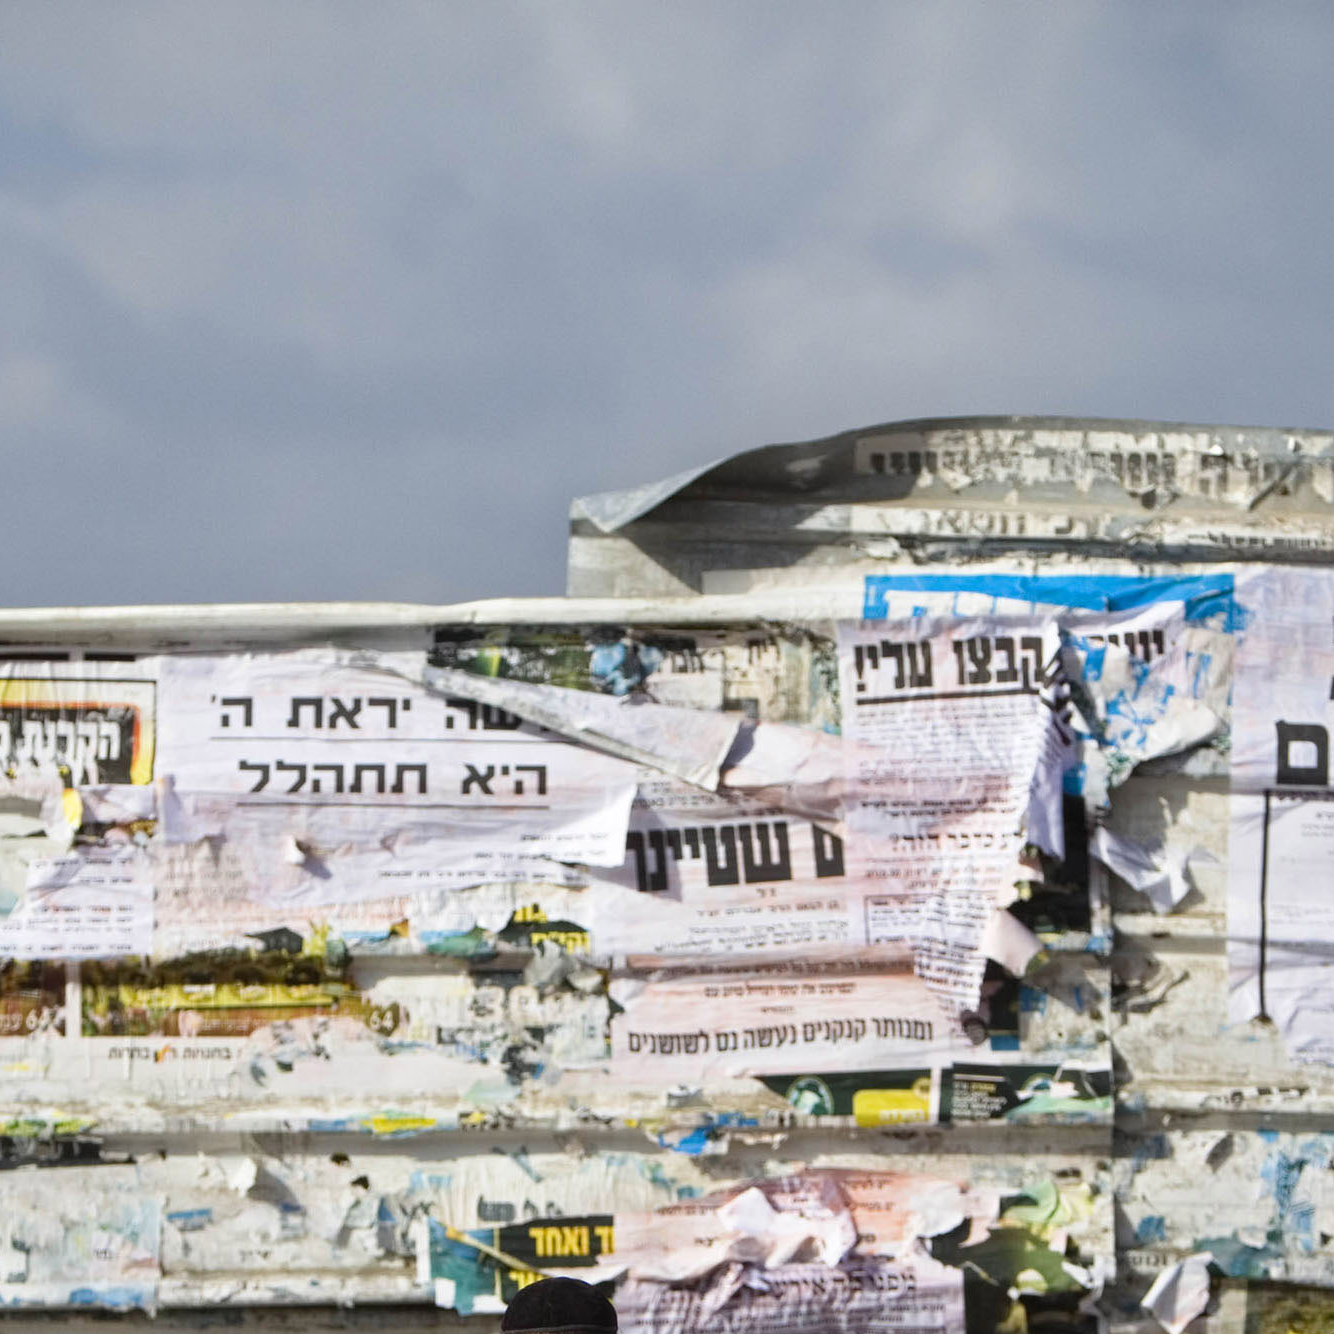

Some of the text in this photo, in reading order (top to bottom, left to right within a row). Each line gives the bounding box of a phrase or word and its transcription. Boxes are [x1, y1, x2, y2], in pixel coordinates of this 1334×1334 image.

[854, 640, 934, 692] עלי!
[288, 696, 412, 731] יראת
[238, 759, 548, 795] היא תתהלל
[626, 821, 792, 893] שטיינר
[368, 1004, 395, 1031] 64
[802, 1017, 867, 1045] קנקנים
[627, 1029, 710, 1056] לשושנים
[743, 1024, 797, 1049] נעשה
[529, 1225, 590, 1257] ואחד
